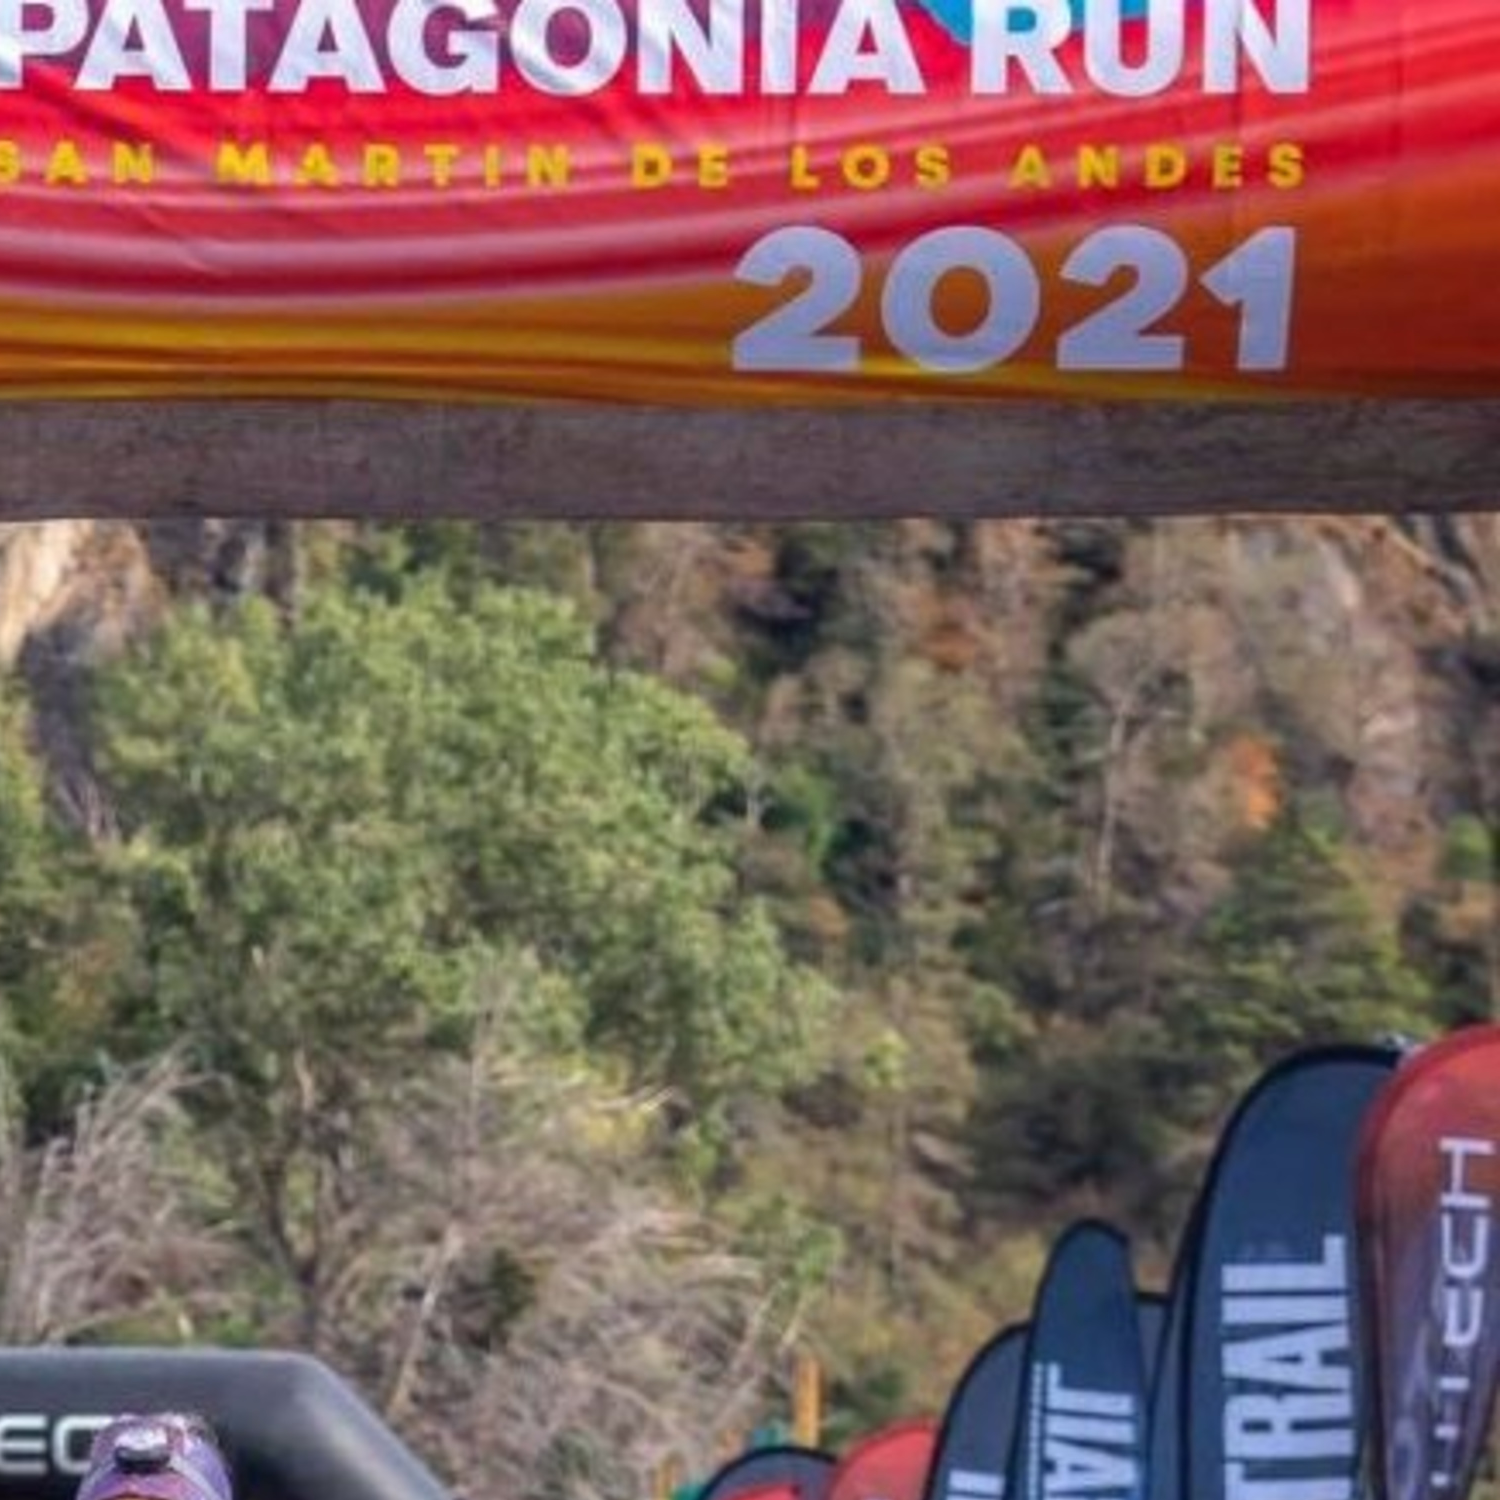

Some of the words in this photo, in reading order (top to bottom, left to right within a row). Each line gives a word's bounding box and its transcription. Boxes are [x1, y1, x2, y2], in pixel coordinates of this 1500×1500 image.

[970, 0, 1310, 96] RUN
[216, 142, 570, 188] MARTIN
[632, 143, 729, 188] DE
[791, 145, 952, 188] LOS
[1008, 144, 1306, 189] ANDES
[732, 224, 1297, 372] 2021
